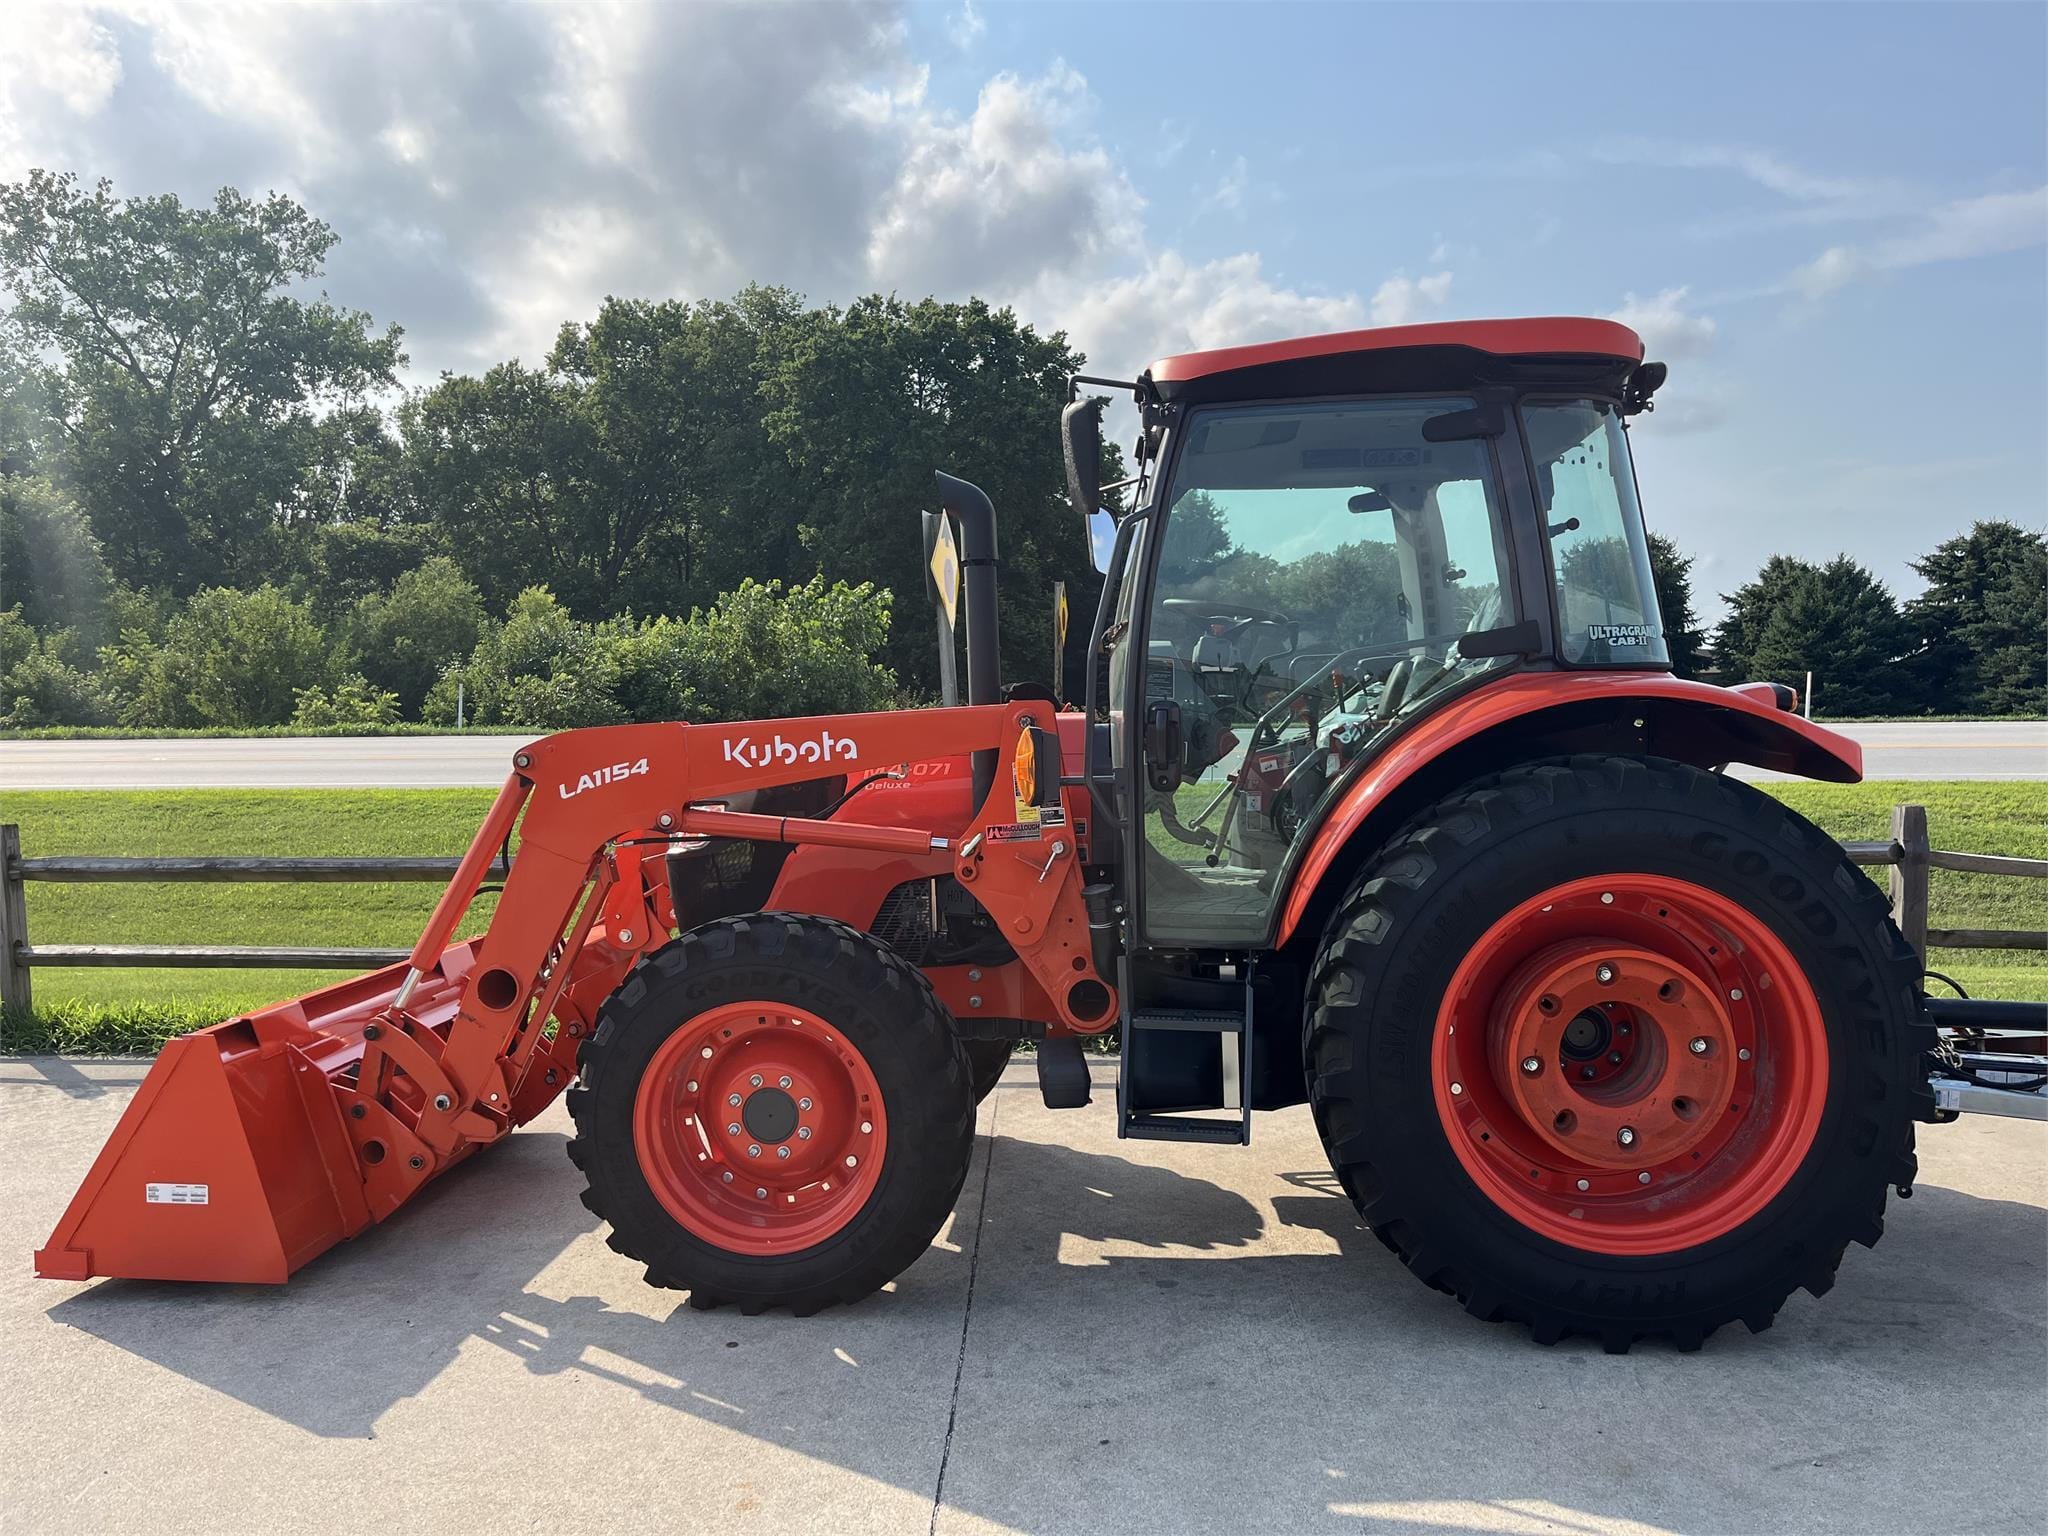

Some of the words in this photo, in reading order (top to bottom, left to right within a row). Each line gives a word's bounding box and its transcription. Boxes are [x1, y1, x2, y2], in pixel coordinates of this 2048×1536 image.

[723, 731, 858, 768] Kubota
[559, 758, 649, 799] LA1154
[865, 781, 911, 791] Deluxe
